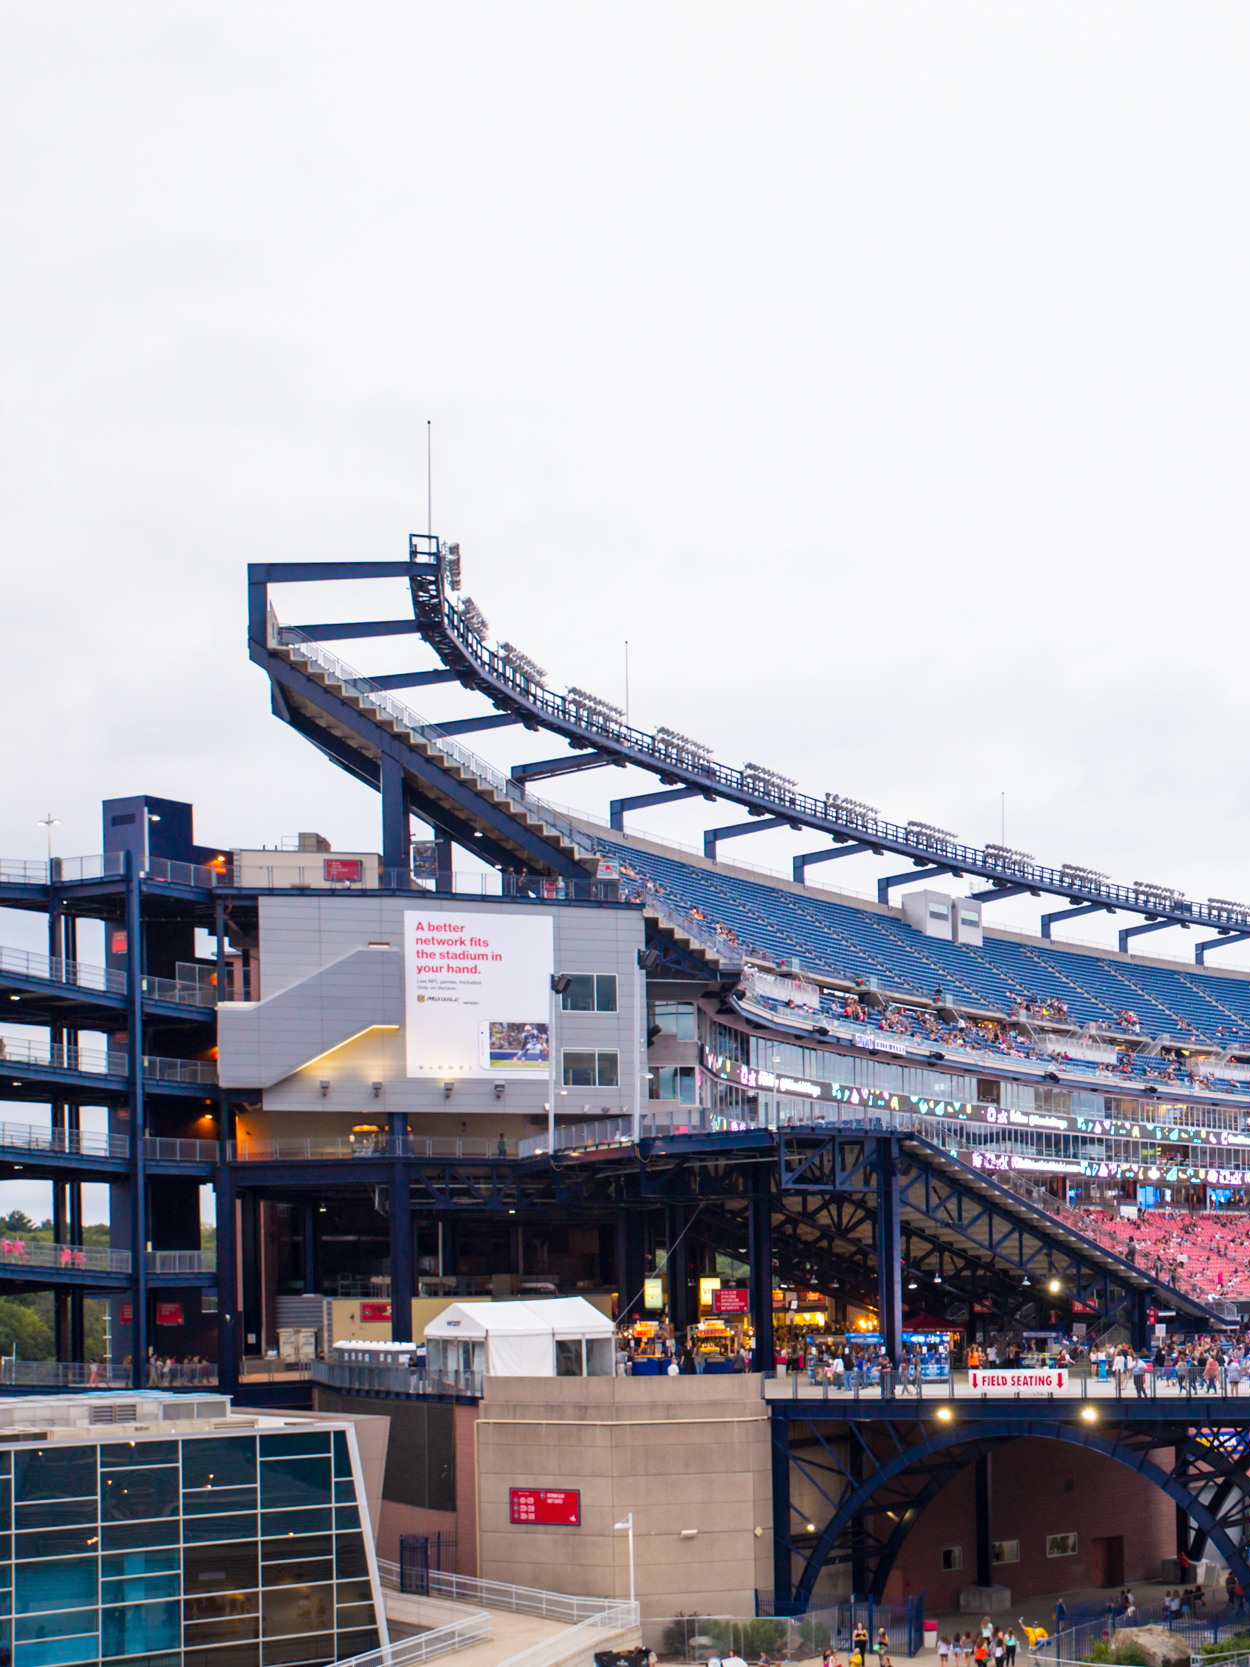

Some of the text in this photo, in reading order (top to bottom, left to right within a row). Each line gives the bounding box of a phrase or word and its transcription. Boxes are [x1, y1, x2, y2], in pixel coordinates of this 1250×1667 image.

[415, 921, 466, 933] A better
[415, 936, 489, 947] network fits
[416, 949, 502, 961] the stadium in
[416, 964, 481, 975] your hand.
[982, 1375, 1052, 1386] FIELD SEATING
